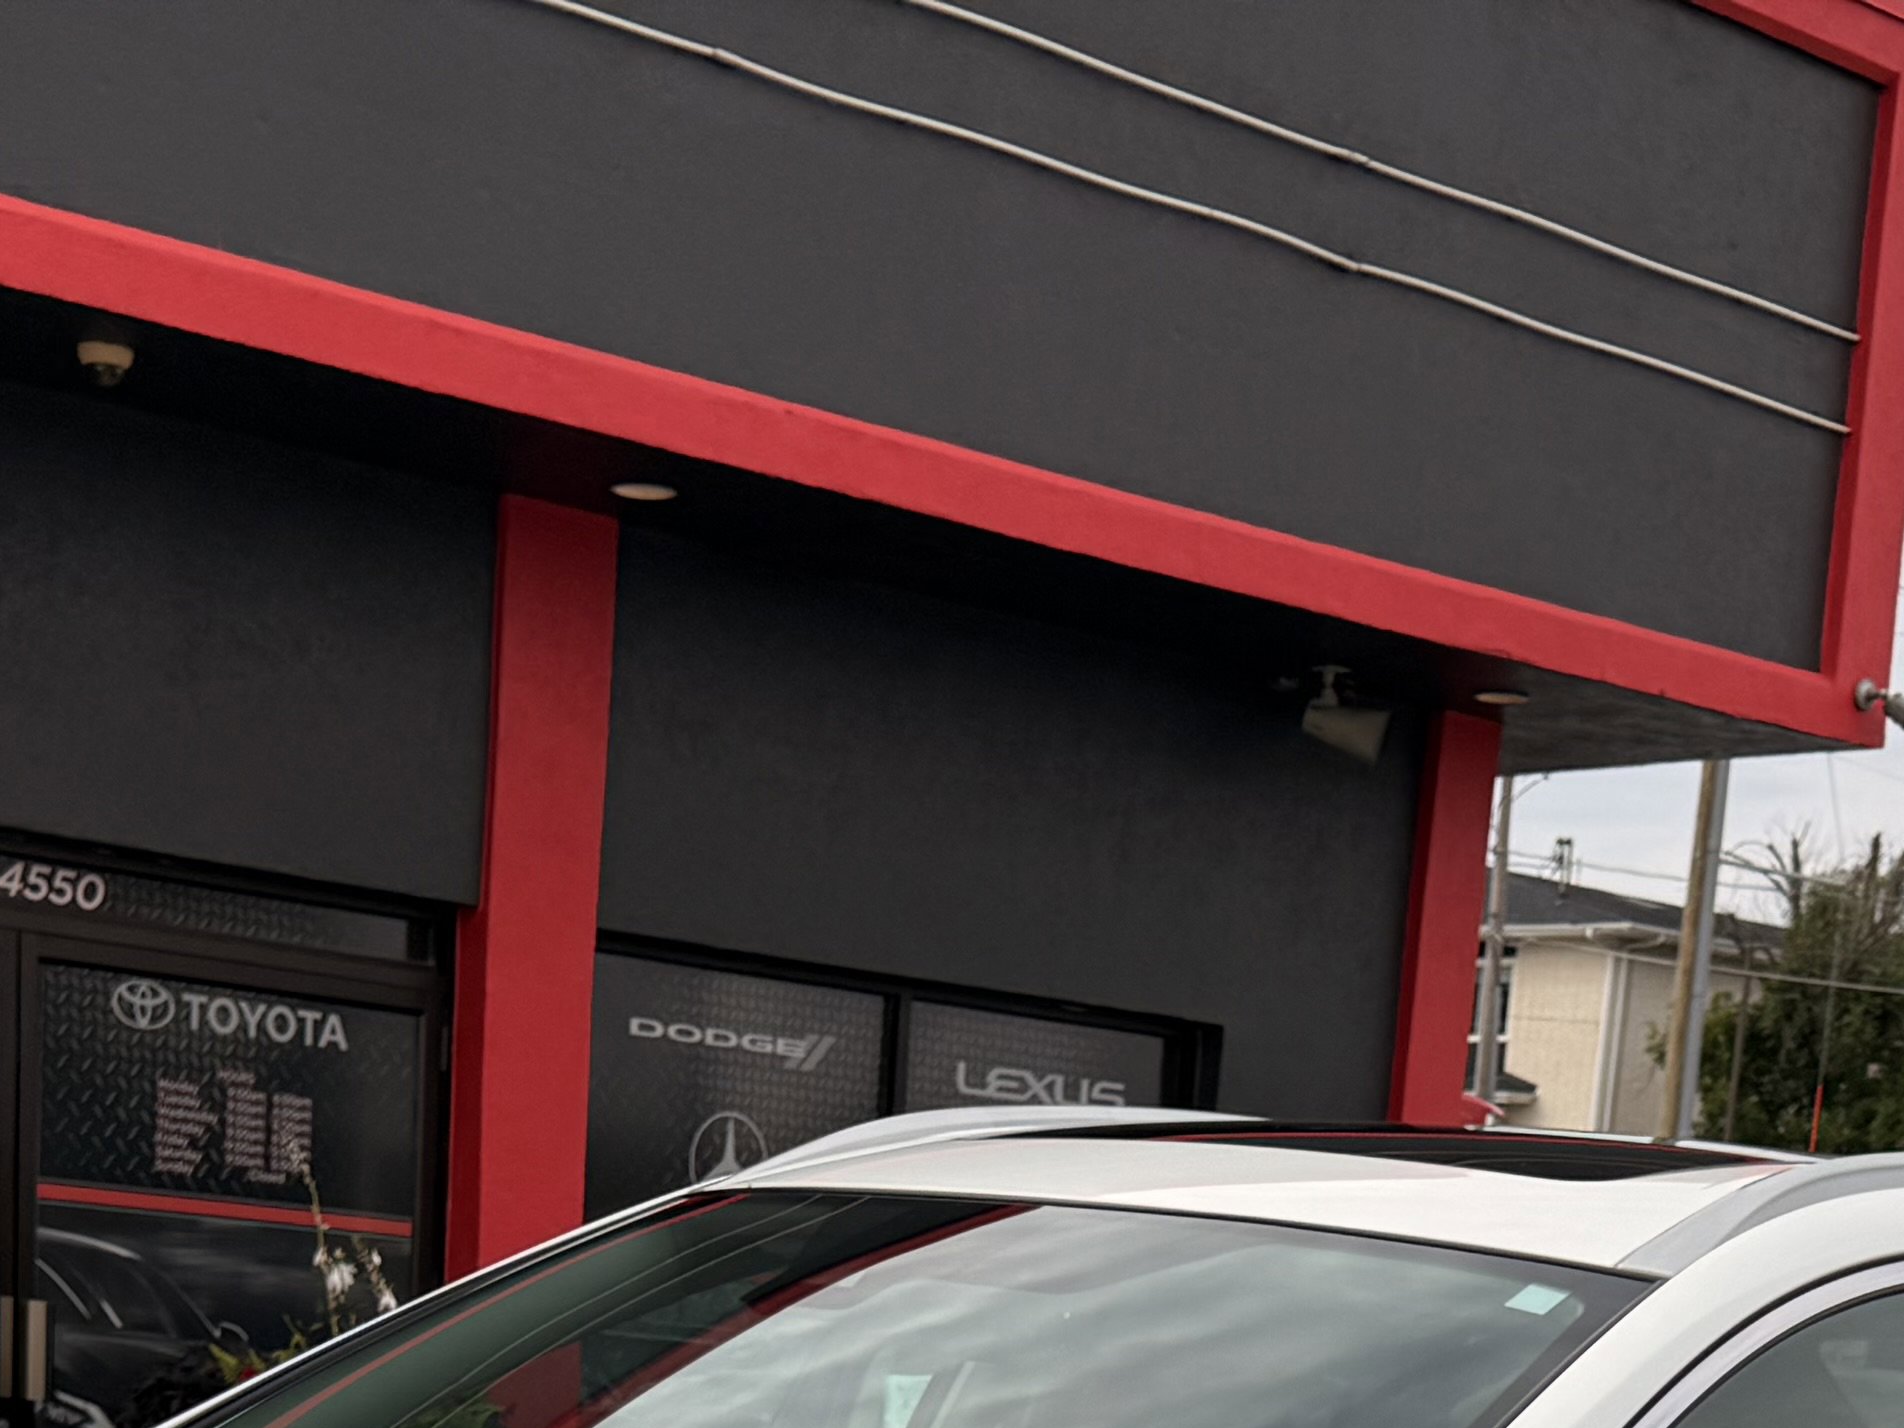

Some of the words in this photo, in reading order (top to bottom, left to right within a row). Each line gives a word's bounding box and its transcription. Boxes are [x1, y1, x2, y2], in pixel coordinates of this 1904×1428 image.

[182, 992, 350, 1053] TOYOTA
[629, 1016, 806, 1058] DODGE
[955, 1060, 1126, 1107] LEXUS
